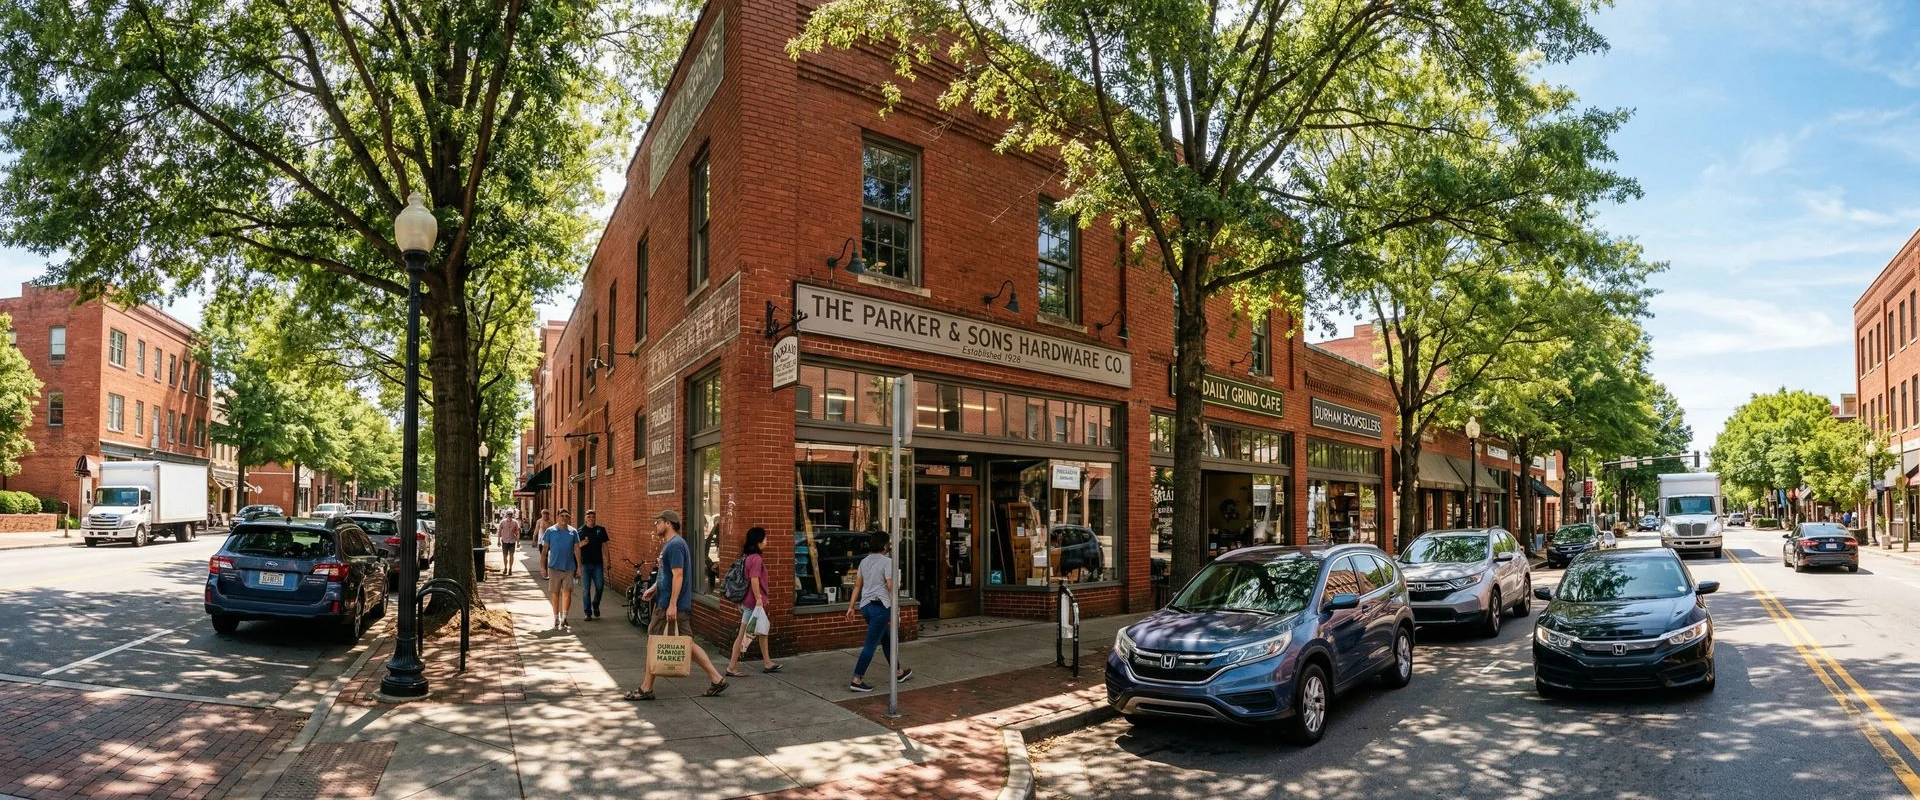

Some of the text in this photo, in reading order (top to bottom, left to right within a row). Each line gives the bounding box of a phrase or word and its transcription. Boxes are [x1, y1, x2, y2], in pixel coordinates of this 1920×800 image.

[812, 294, 1125, 375] THE PARKER & SONS HARDWARE CO.
[962, 345, 1021, 364] Established 1928
[1202, 379, 1281, 412] DAILY GRIND CAFE
[1315, 405, 1342, 424] DURHAM
